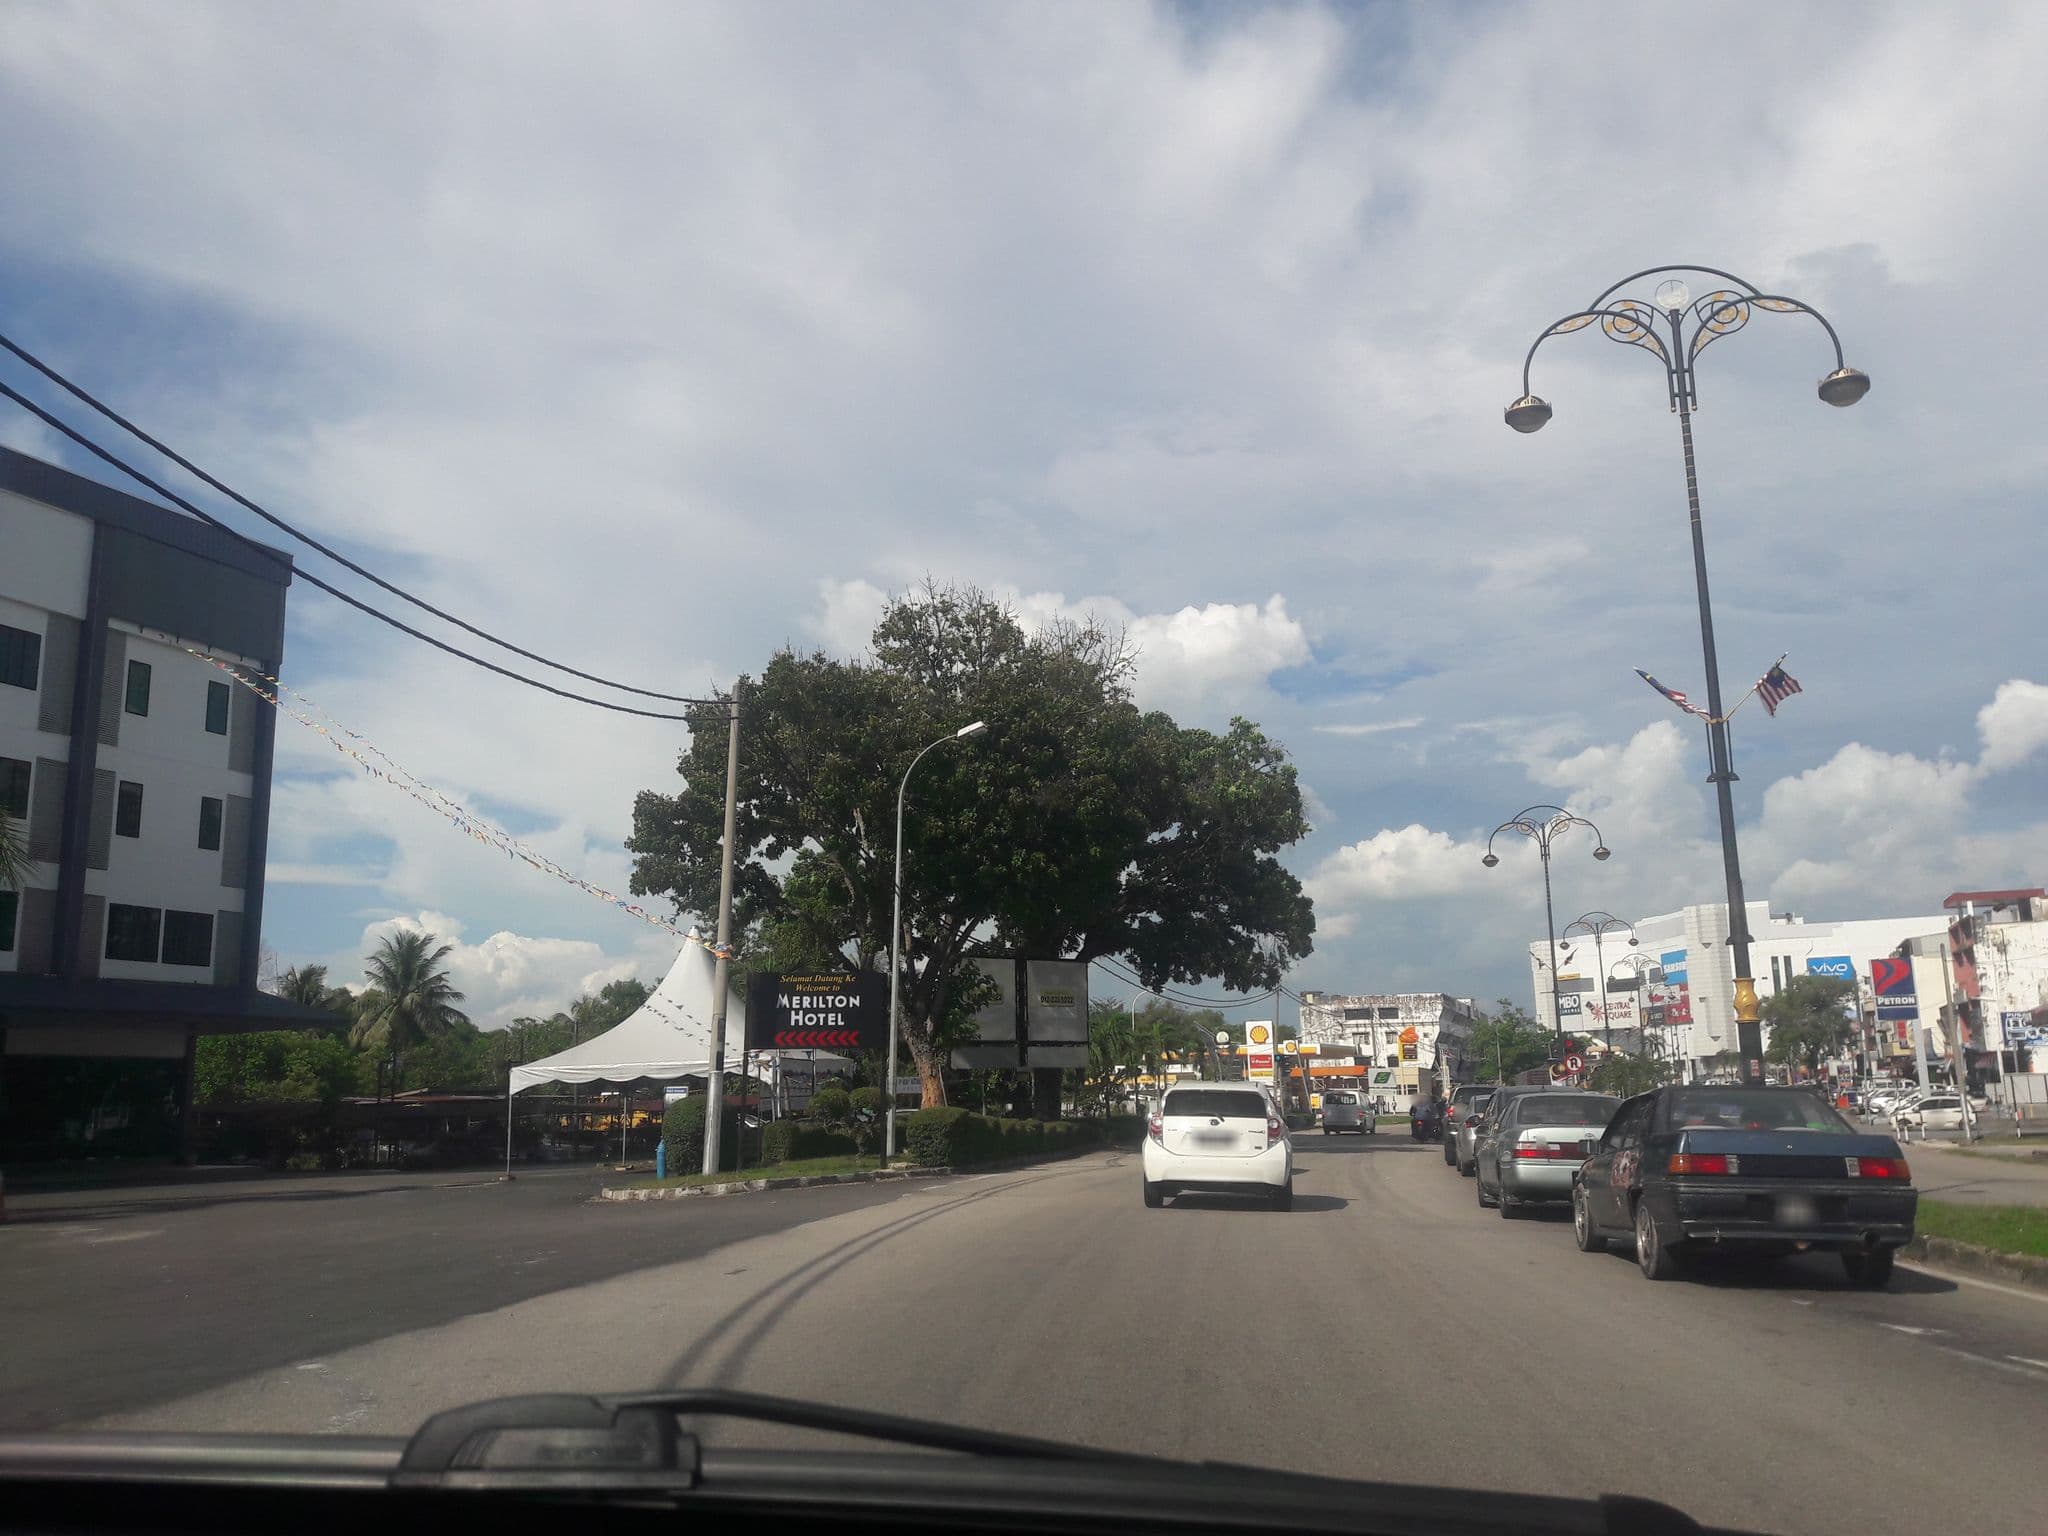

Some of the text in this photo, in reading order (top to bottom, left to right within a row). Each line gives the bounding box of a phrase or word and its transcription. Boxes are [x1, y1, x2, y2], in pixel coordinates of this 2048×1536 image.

[780, 974, 856, 983] Selamat Datang Ke
[795, 984, 841, 992] Welcome to
[776, 993, 860, 1009] MERILTON
[1559, 995, 1579, 1009] MBO
[1877, 996, 1916, 1006] PETRON
[790, 1010, 845, 1026] HOTEL
